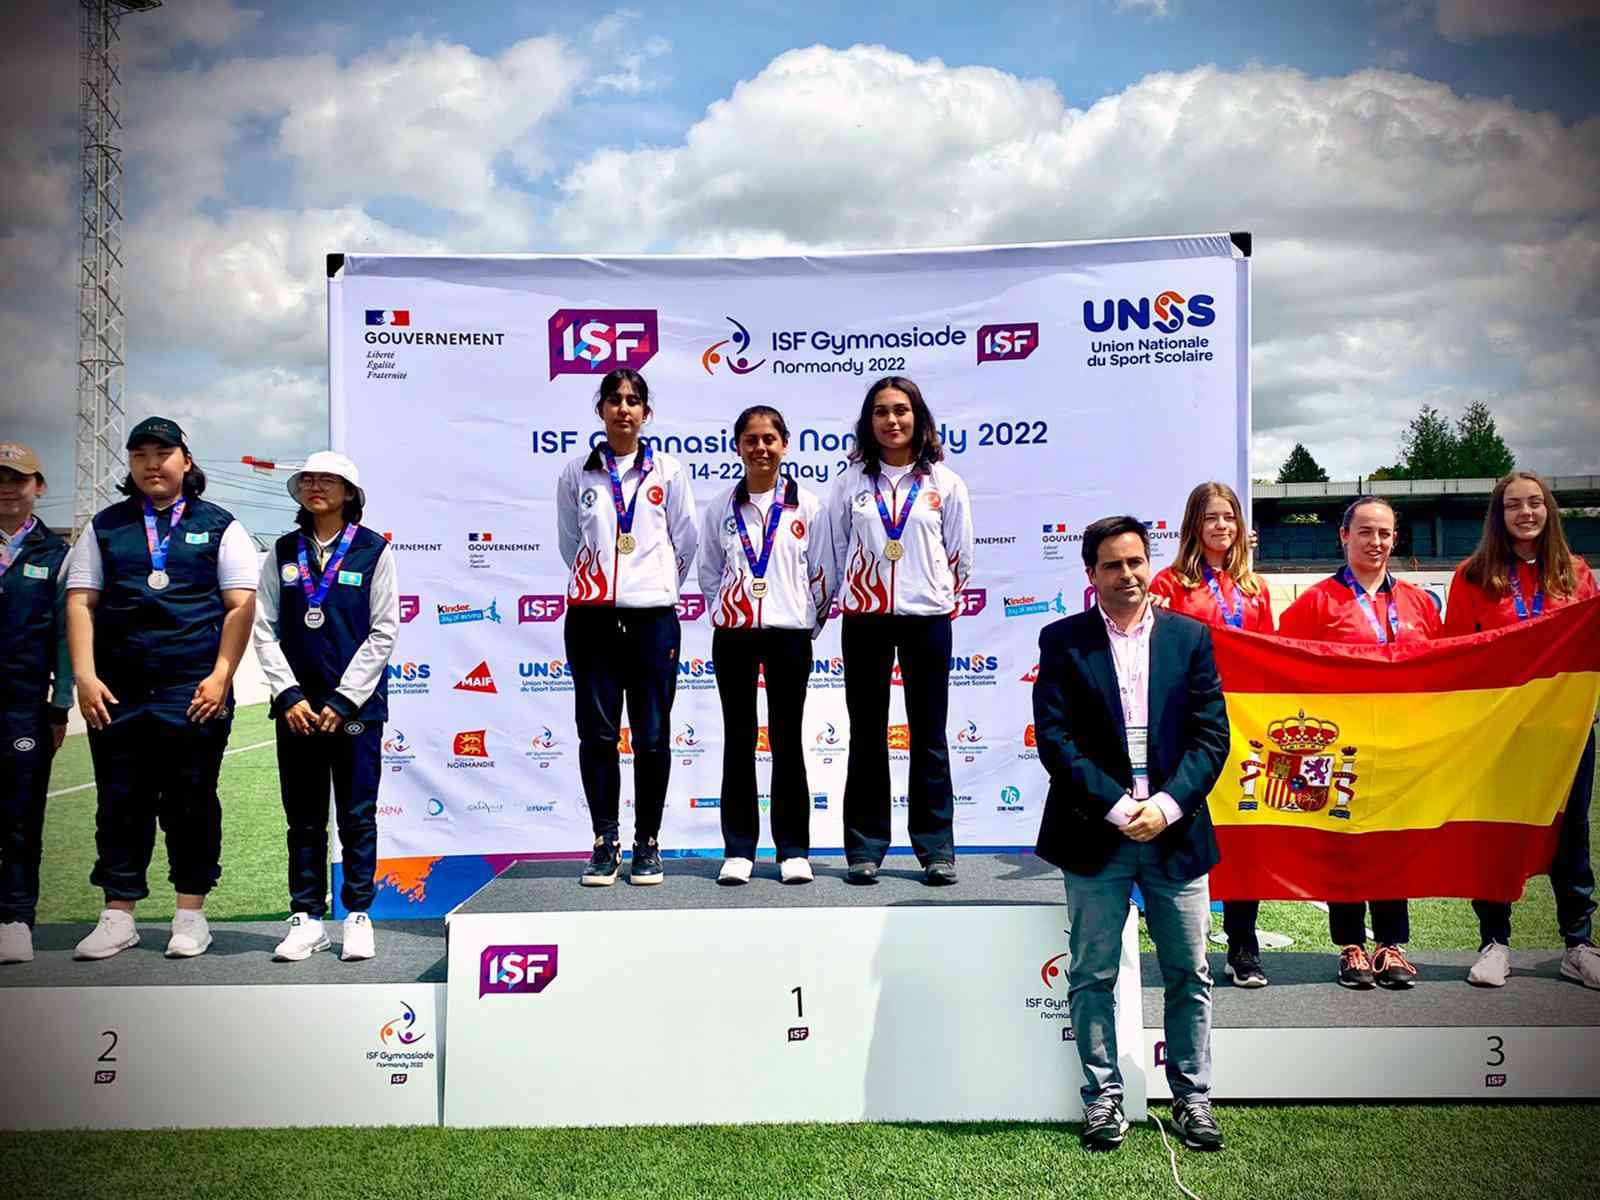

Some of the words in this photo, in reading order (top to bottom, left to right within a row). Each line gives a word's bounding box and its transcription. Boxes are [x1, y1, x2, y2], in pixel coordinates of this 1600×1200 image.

[364, 331, 505, 346] GOUVERNEMENT
[562, 321, 645, 362] ISF
[772, 331, 807, 352] ISF
[811, 326, 967, 355] Gymnasiade
[984, 329, 1032, 355] ISF
[1091, 340, 1135, 353] Union
[1138, 336, 1210, 351] Nationale
[773, 358, 864, 376] Normandy
[868, 357, 906, 372] 2022
[1087, 354, 1107, 367] du
[1110, 352, 1152, 368] Sport
[1154, 349, 1214, 364] Scolaire
[532, 431, 578, 454] ISF
[978, 420, 1048, 447] 2022
[689, 463, 743, 480] 14-22
[779, 461, 828, 483] May
[468, 543, 541, 551] GOUVERNEMENT
[524, 599, 560, 617] ISF
[676, 600, 700, 616] SF
[387, 662, 430, 681] NSS
[678, 657, 716, 677] NSS
[462, 677, 493, 688] MAIF
[447, 761, 495, 769] NORMANDIE
[489, 953, 549, 984] ISF
[791, 986, 803, 1018] 1
[1026, 998, 1042, 1008] ISF
[98, 1031, 118, 1061] 2
[1487, 1036, 1505, 1066] 3
[380, 1051, 434, 1061] Gymnasiade
